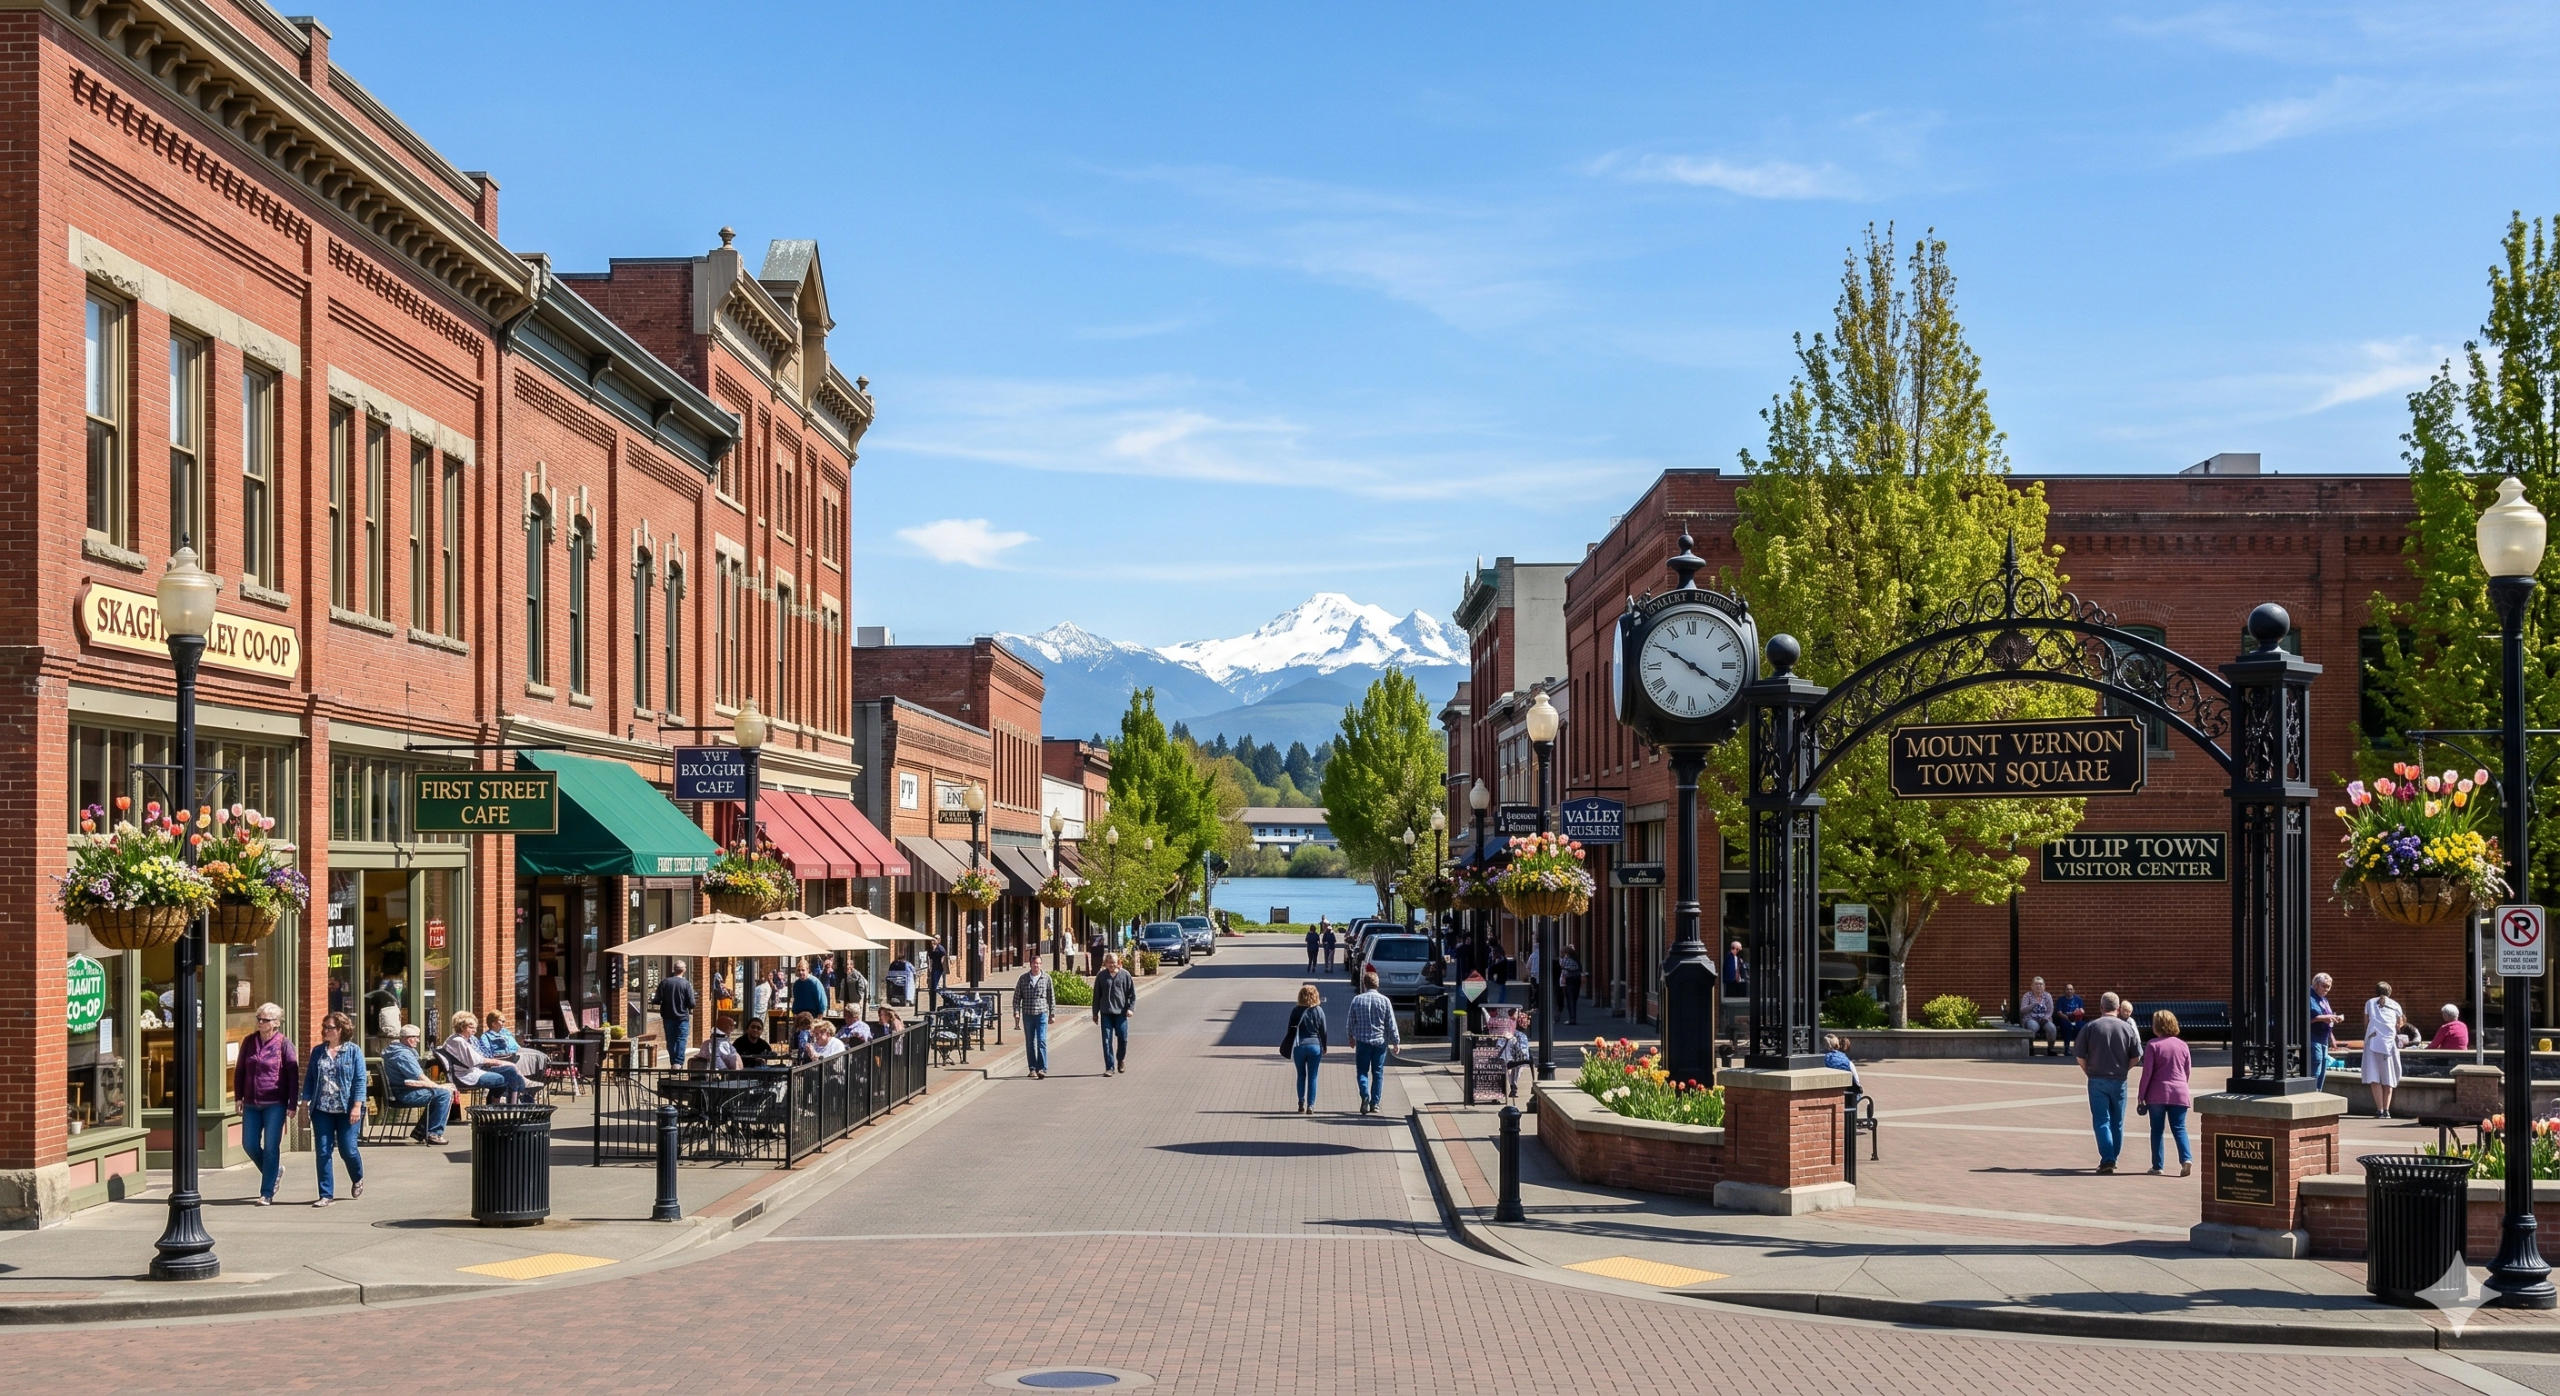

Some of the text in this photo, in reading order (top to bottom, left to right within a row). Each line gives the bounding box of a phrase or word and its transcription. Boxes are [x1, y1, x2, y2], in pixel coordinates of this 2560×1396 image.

[243, 629, 291, 666] CO-OP
[1906, 730, 2124, 758] MOUNT VERNON
[1917, 760, 2111, 788] TOWN SQUARE
[421, 781, 549, 799] FIRST STREET
[696, 781, 735, 793] CAFE
[461, 806, 510, 824] CAFE
[1564, 810, 1621, 823] VALLEY
[2049, 838, 2219, 858] TULIP TOWN
[2055, 862, 2213, 876] VISITOR CENTER
[67, 998, 101, 1020] CO-OP
[2225, 1139, 2263, 1151] MOUNT
